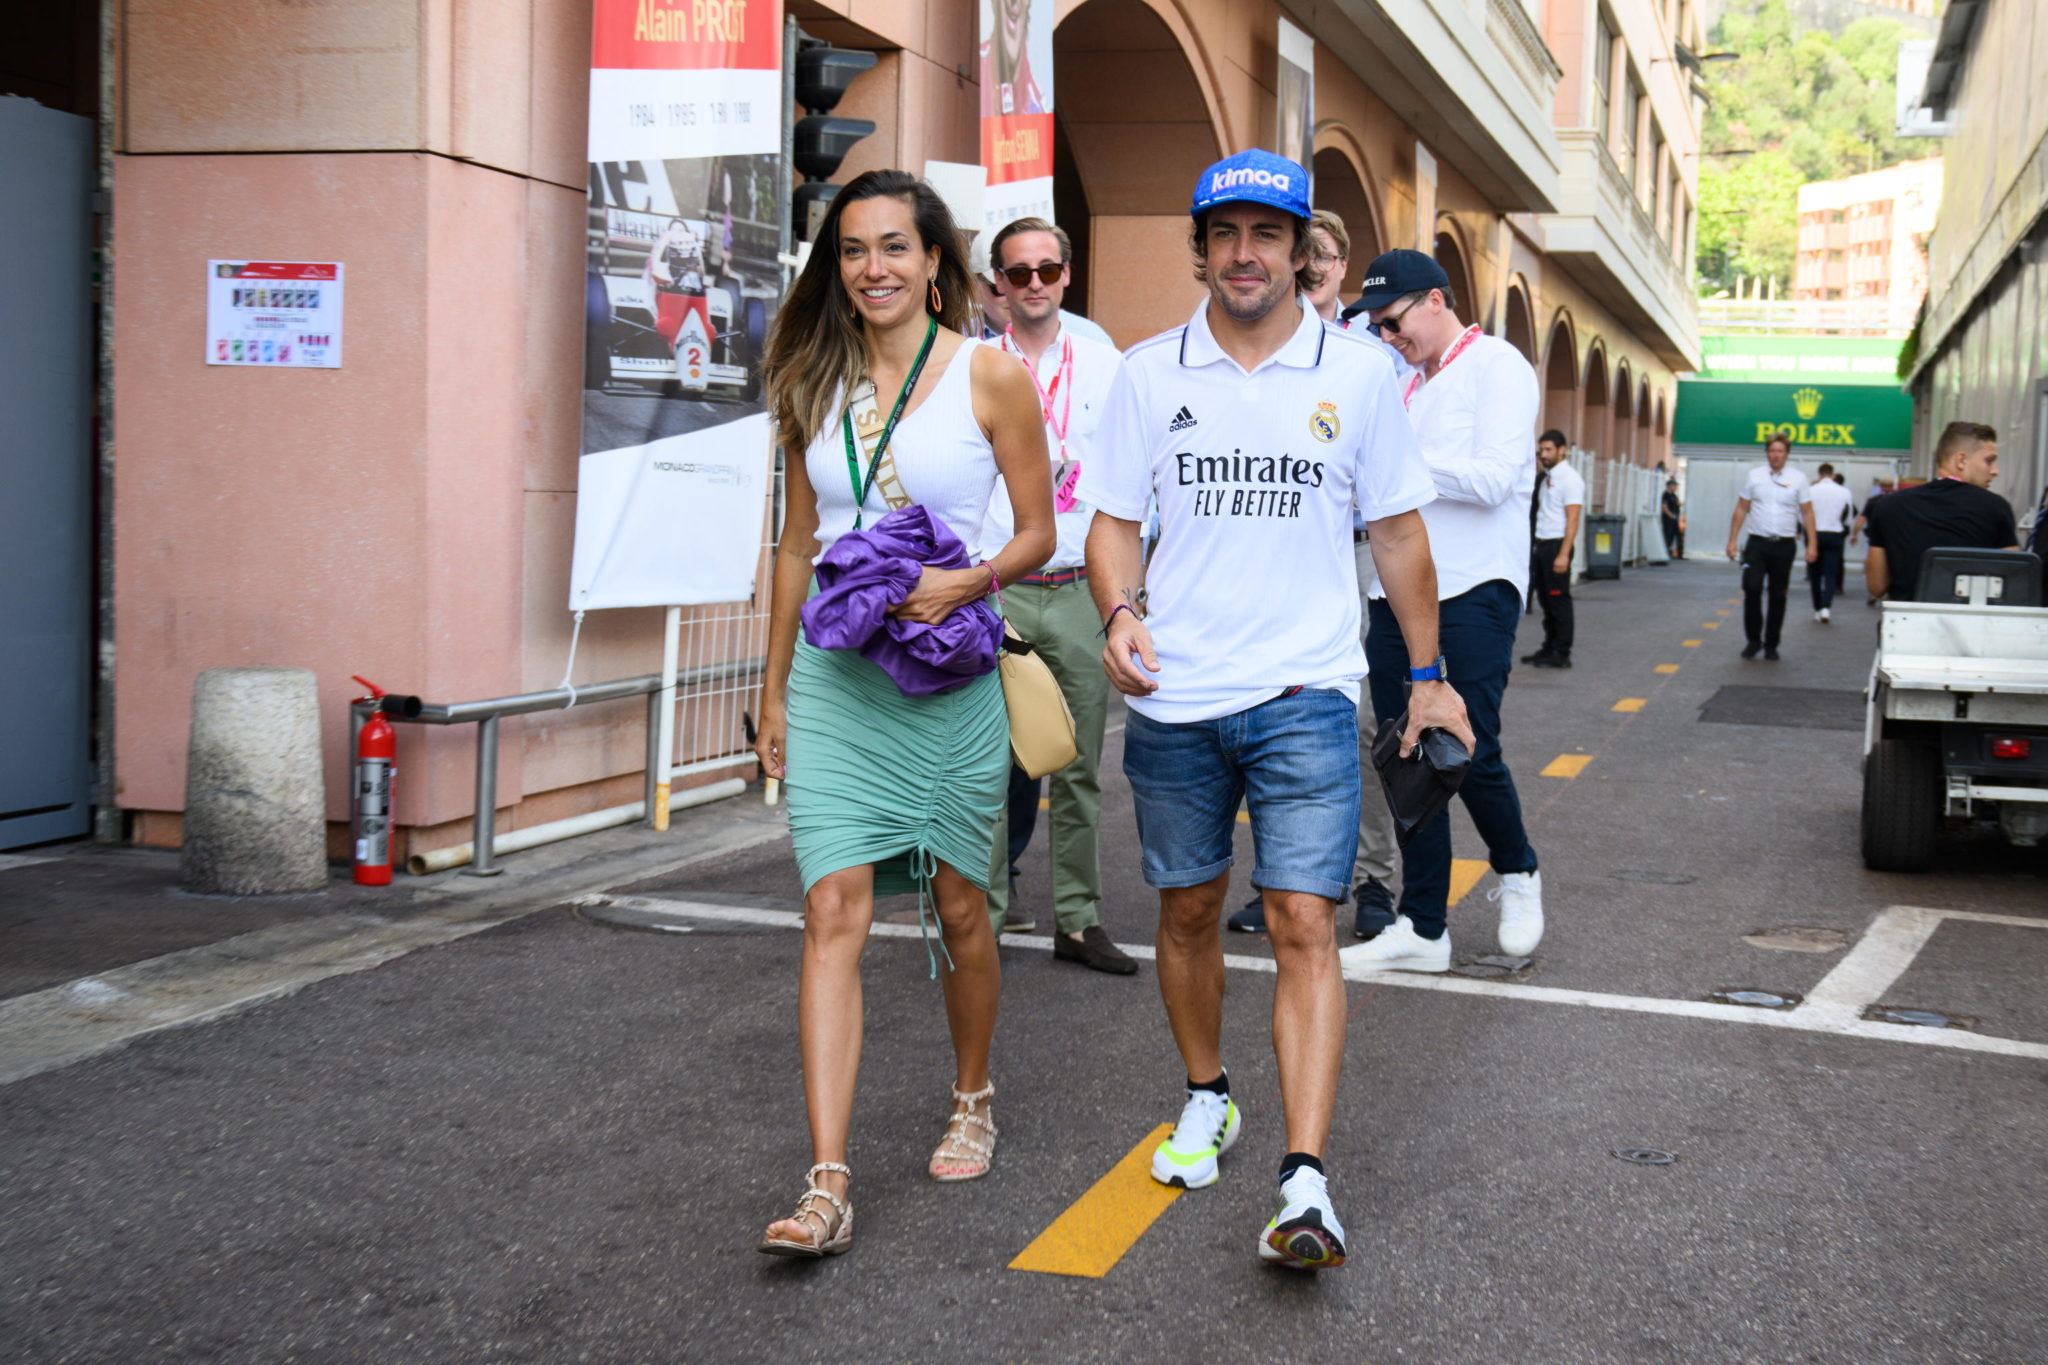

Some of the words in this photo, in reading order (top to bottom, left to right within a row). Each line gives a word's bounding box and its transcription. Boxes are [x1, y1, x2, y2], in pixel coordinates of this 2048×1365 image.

[634, 0, 687, 42] Alain
[1211, 168, 1290, 194] kimoa
[688, 347, 701, 366] 2
[1169, 418, 1198, 433] adidas
[1755, 422, 1856, 445] ROLEX
[1175, 448, 1325, 489] Emirates
[1194, 489, 1226, 517] FLY
[1230, 489, 1302, 518] BETTER
